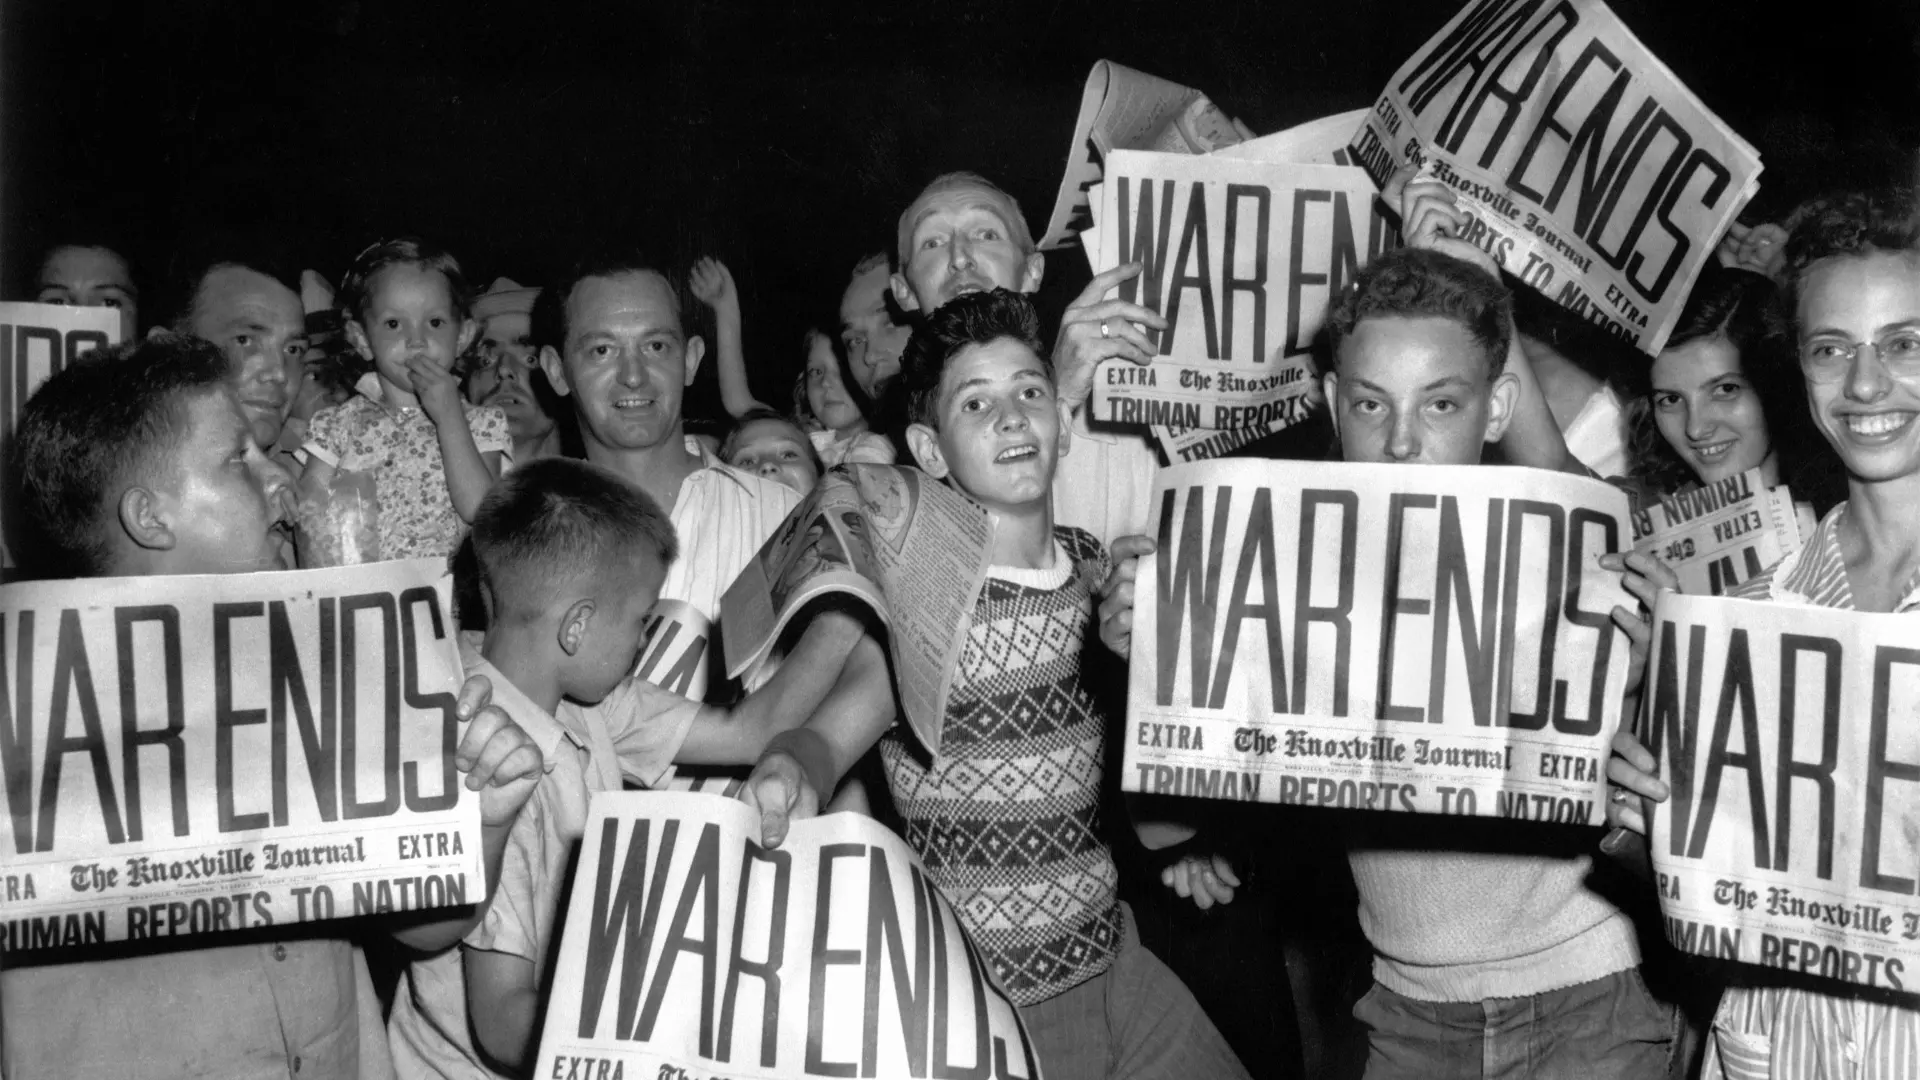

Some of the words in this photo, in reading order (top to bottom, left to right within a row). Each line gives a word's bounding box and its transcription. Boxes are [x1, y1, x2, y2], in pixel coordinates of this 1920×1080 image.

[1398, 0, 1580, 170] WAR
[1505, 36, 1731, 304] ENDS
[1376, 96, 1402, 138] EXTRA
[1430, 159, 1521, 221] Knoxville
[1523, 212, 1593, 274] Journal
[1604, 283, 1649, 328] EXTRA
[1117, 176, 1271, 363] WAR
[1458, 211, 1515, 265] ORTS
[1521, 251, 1555, 292] TO
[1106, 396, 1200, 427] TRUMAN
[1107, 367, 1157, 387] EXTRA
[1179, 368, 1212, 392] The
[1217, 366, 1304, 393] Knoxville
[1661, 472, 1755, 528] TRUMAN
[1713, 510, 1762, 543] EXTRA
[1665, 537, 1697, 562] The
[1155, 485, 1360, 718] WAR
[1375, 492, 1620, 737] ENDS
[213, 586, 459, 833] ENDS
[1137, 721, 1204, 751] EXTRA
[1234, 726, 1277, 756] The
[1283, 729, 1407, 764] Knoxville
[1414, 738, 1513, 771] Journal
[1539, 752, 1598, 783] EXTRA
[1637, 620, 1843, 880] WAR
[1136, 763, 1261, 802] TRUMAN
[1279, 774, 1417, 812] REPORTS
[1436, 786, 1478, 816] TO
[1497, 790, 1594, 826] NATION
[70, 863, 119, 892] The
[126, 848, 255, 887] Knoxville
[263, 836, 367, 870] Journal
[398, 830, 464, 860] EXTRA
[127, 890, 274, 940] REPORTS
[290, 885, 335, 923] TO
[352, 873, 467, 916] NATION
[1713, 878, 1758, 911] The
[1766, 887, 1894, 936] Knoxville
[578, 817, 792, 1068] WAR
[1664, 913, 1741, 960] UMAN
[1760, 932, 1905, 993] REPORTS
[551, 1055, 624, 1080] EXTRA
